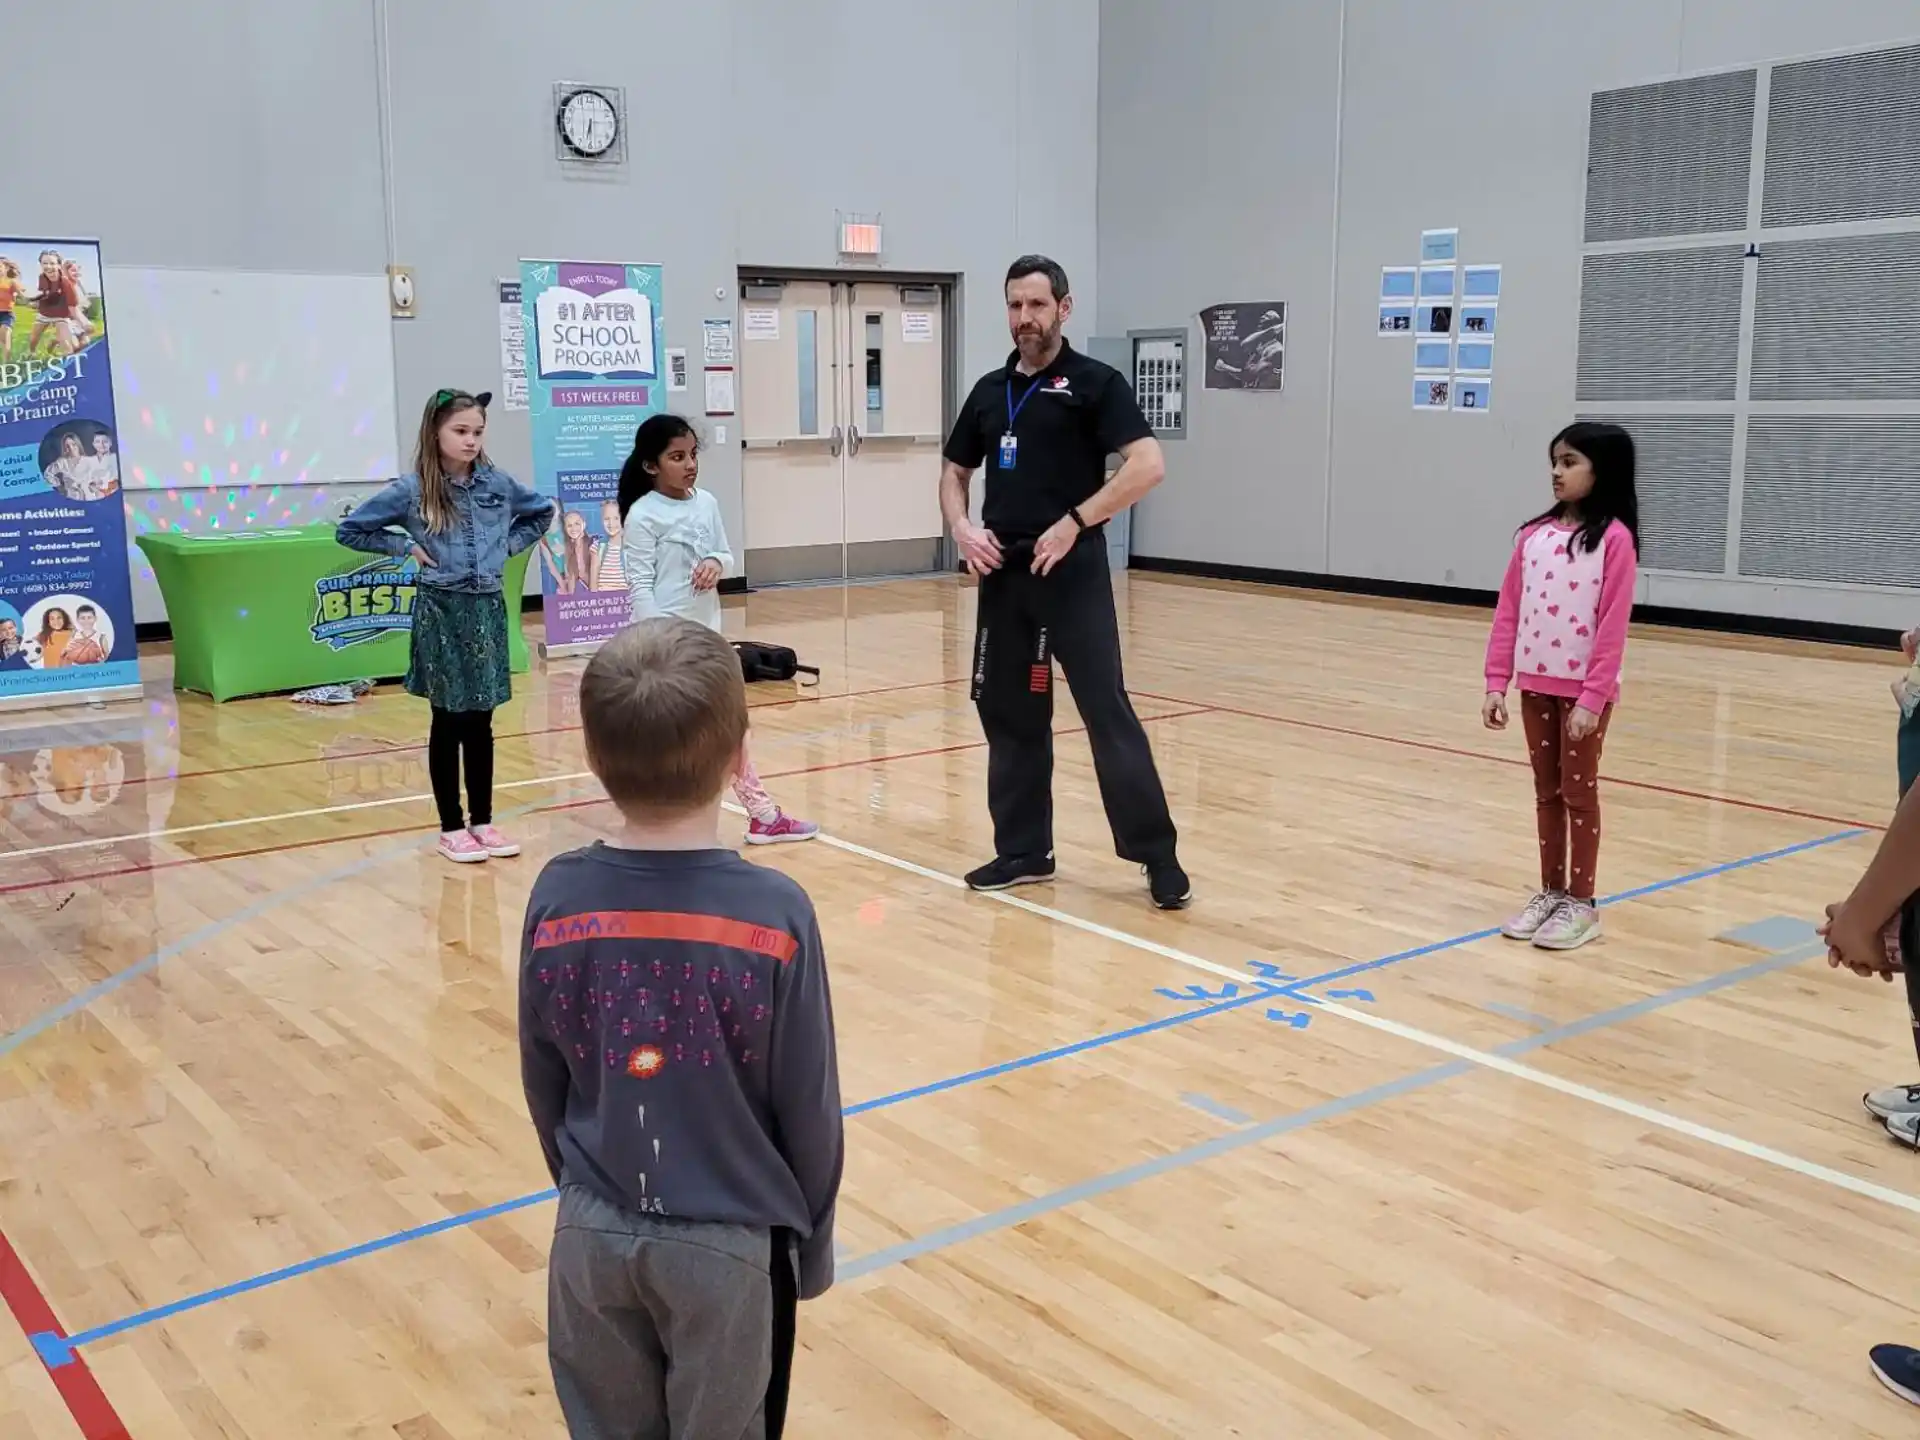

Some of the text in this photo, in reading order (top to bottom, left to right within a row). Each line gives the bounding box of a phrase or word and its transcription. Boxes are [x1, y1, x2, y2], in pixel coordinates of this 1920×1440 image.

[582, 302, 636, 321] AFTER
[552, 323, 641, 347] SCHOOL
[554, 348, 641, 367] PROGRAM
[26, 385, 78, 402] Camp
[561, 391, 640, 404] 1ST WEEK FREE!
[12, 398, 76, 422] Prairie!
[4, 453, 32, 465] child
[24, 507, 85, 520] Activities:
[33, 529, 62, 537] Indoor
[322, 585, 418, 621] BEST
[559, 608, 591, 620] BEFORE
[592, 608, 605, 616] WE
